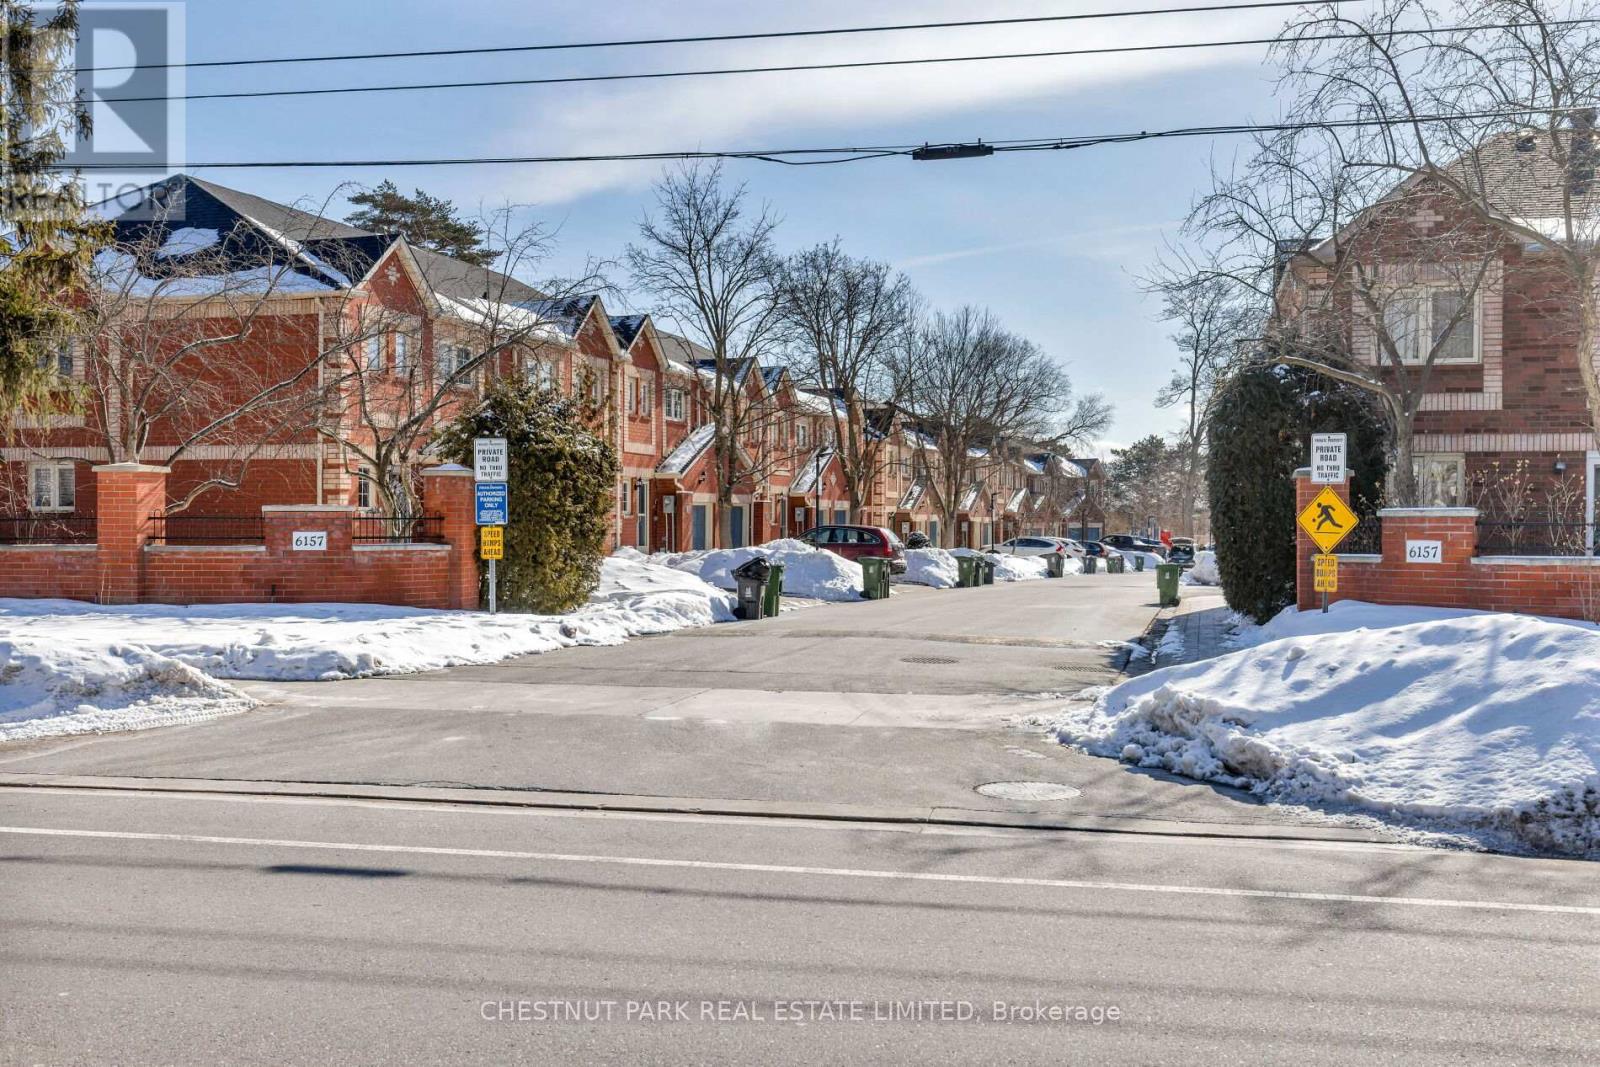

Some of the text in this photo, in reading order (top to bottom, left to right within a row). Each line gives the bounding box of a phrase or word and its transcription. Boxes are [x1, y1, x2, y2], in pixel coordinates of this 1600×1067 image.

[295, 536, 324, 546] 6157
[1409, 545, 1438, 558] 6157
[1317, 558, 1334, 566] SPEED
[1317, 579, 1335, 588] AHAD
